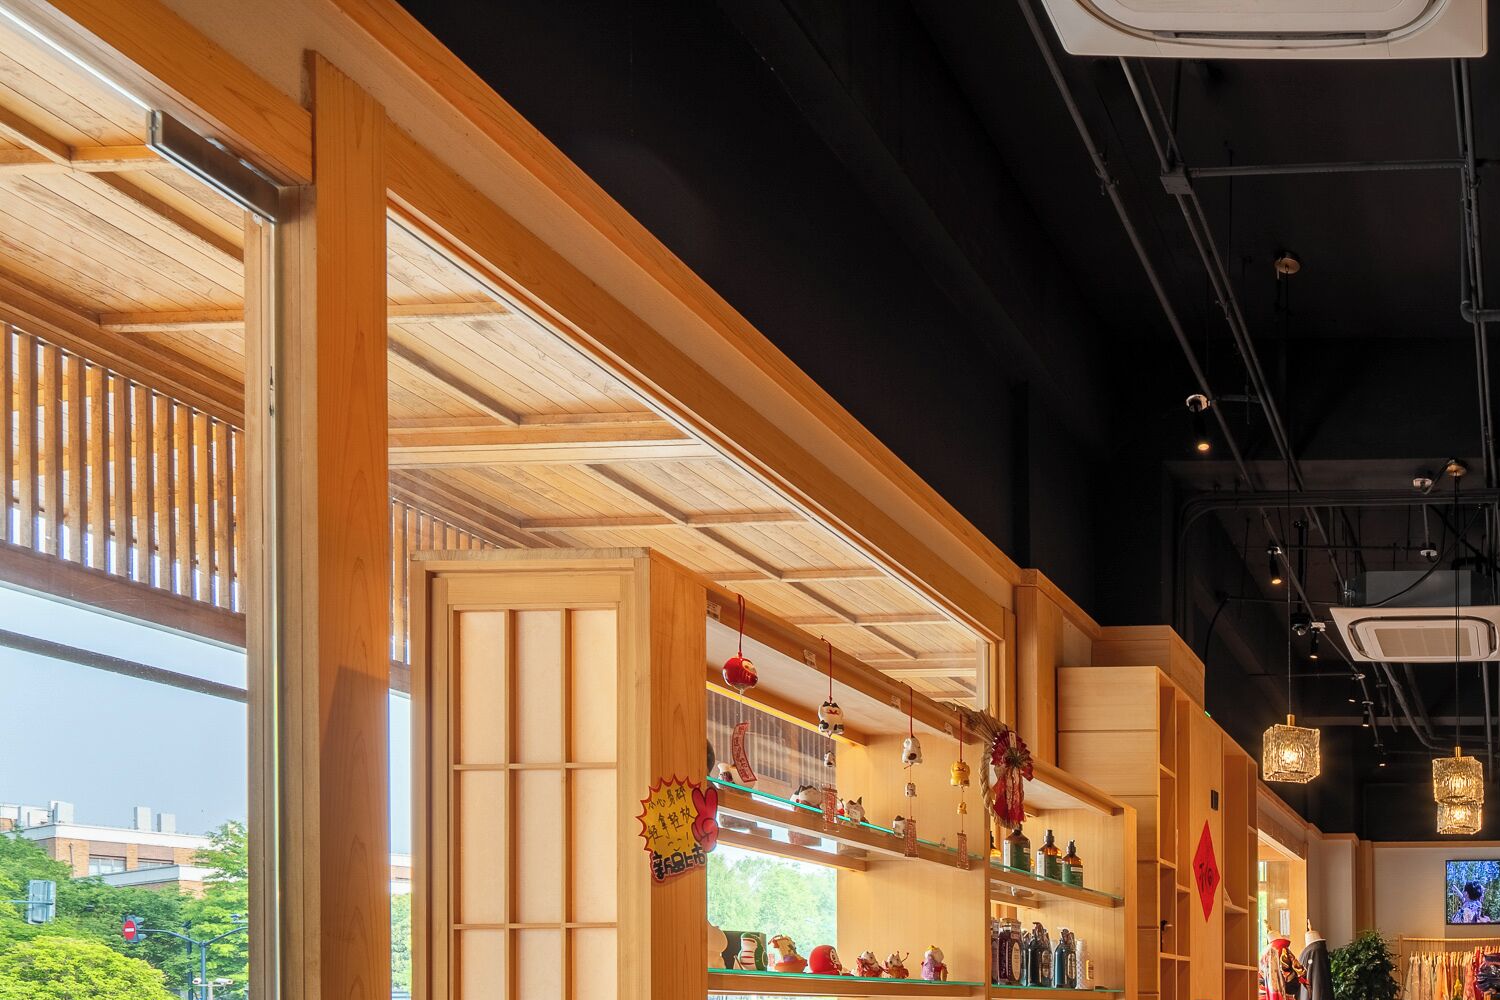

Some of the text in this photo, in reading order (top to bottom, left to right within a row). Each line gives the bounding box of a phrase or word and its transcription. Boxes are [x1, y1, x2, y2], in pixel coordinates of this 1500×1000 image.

[648, 786, 687, 810] 小心易碎
[647, 805, 695, 844] 轻拿轻放
[653, 843, 707, 880] 新品上市
